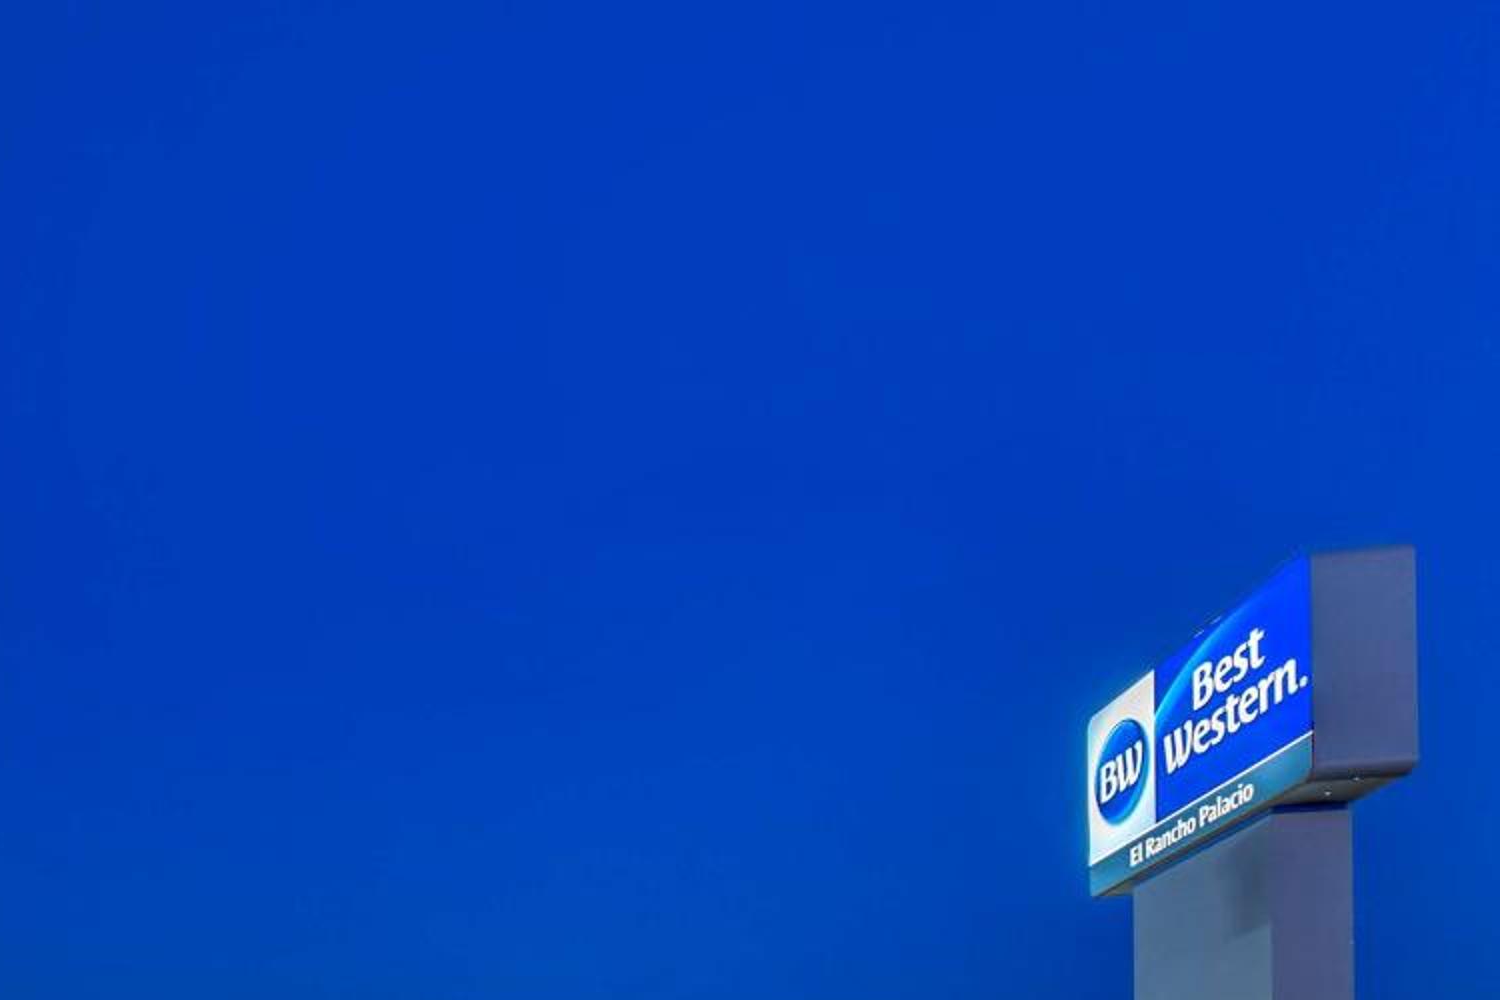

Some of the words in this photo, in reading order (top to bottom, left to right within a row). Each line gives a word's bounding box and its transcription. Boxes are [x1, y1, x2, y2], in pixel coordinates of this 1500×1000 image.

[1192, 628, 1265, 711] Best
[1100, 740, 1143, 803] BW
[1129, 843, 1144, 867] El
[1145, 821, 1197, 856] Rancho
[1199, 783, 1254, 829] Palacio
